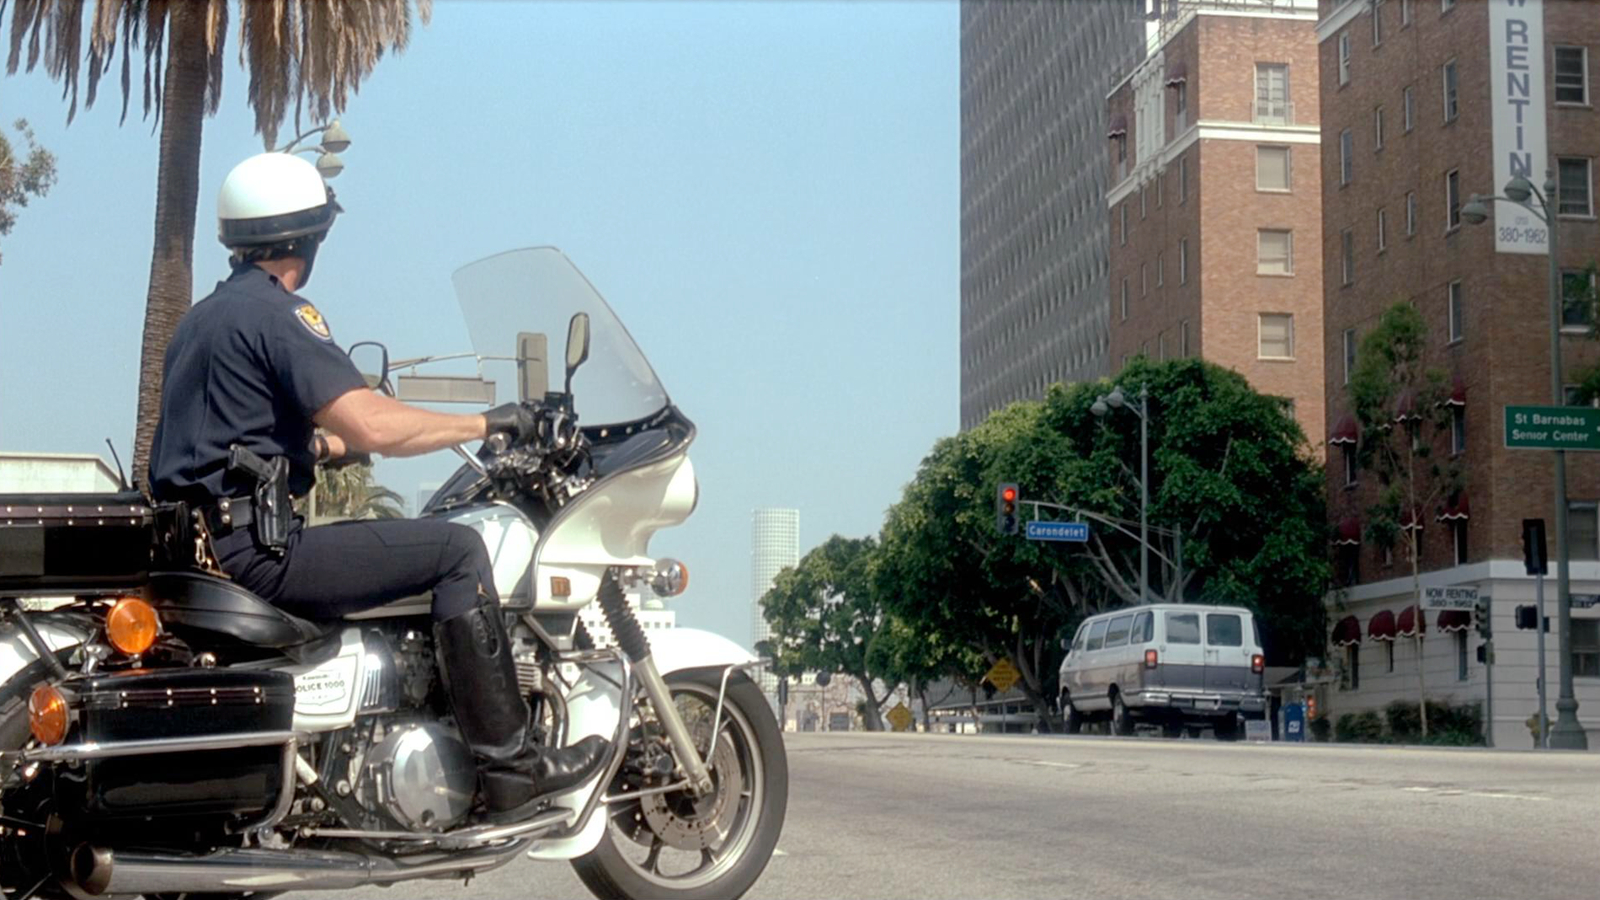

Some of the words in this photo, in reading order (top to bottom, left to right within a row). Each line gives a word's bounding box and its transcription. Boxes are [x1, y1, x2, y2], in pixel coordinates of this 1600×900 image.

[1505, 18, 1532, 207] RENTIN
[1498, 226, 1547, 244] 380-1962
[1514, 413, 1528, 424] St
[1532, 413, 1586, 426] Barnabas
[1511, 428, 1548, 440] Senior
[1552, 430, 1589, 442] Center
[1029, 525, 1085, 537] Carondelet
[1425, 587, 1445, 598] NOW
[1446, 588, 1478, 600] RENTING
[295, 682, 322, 693] OLICE
[324, 679, 345, 689] 1000
